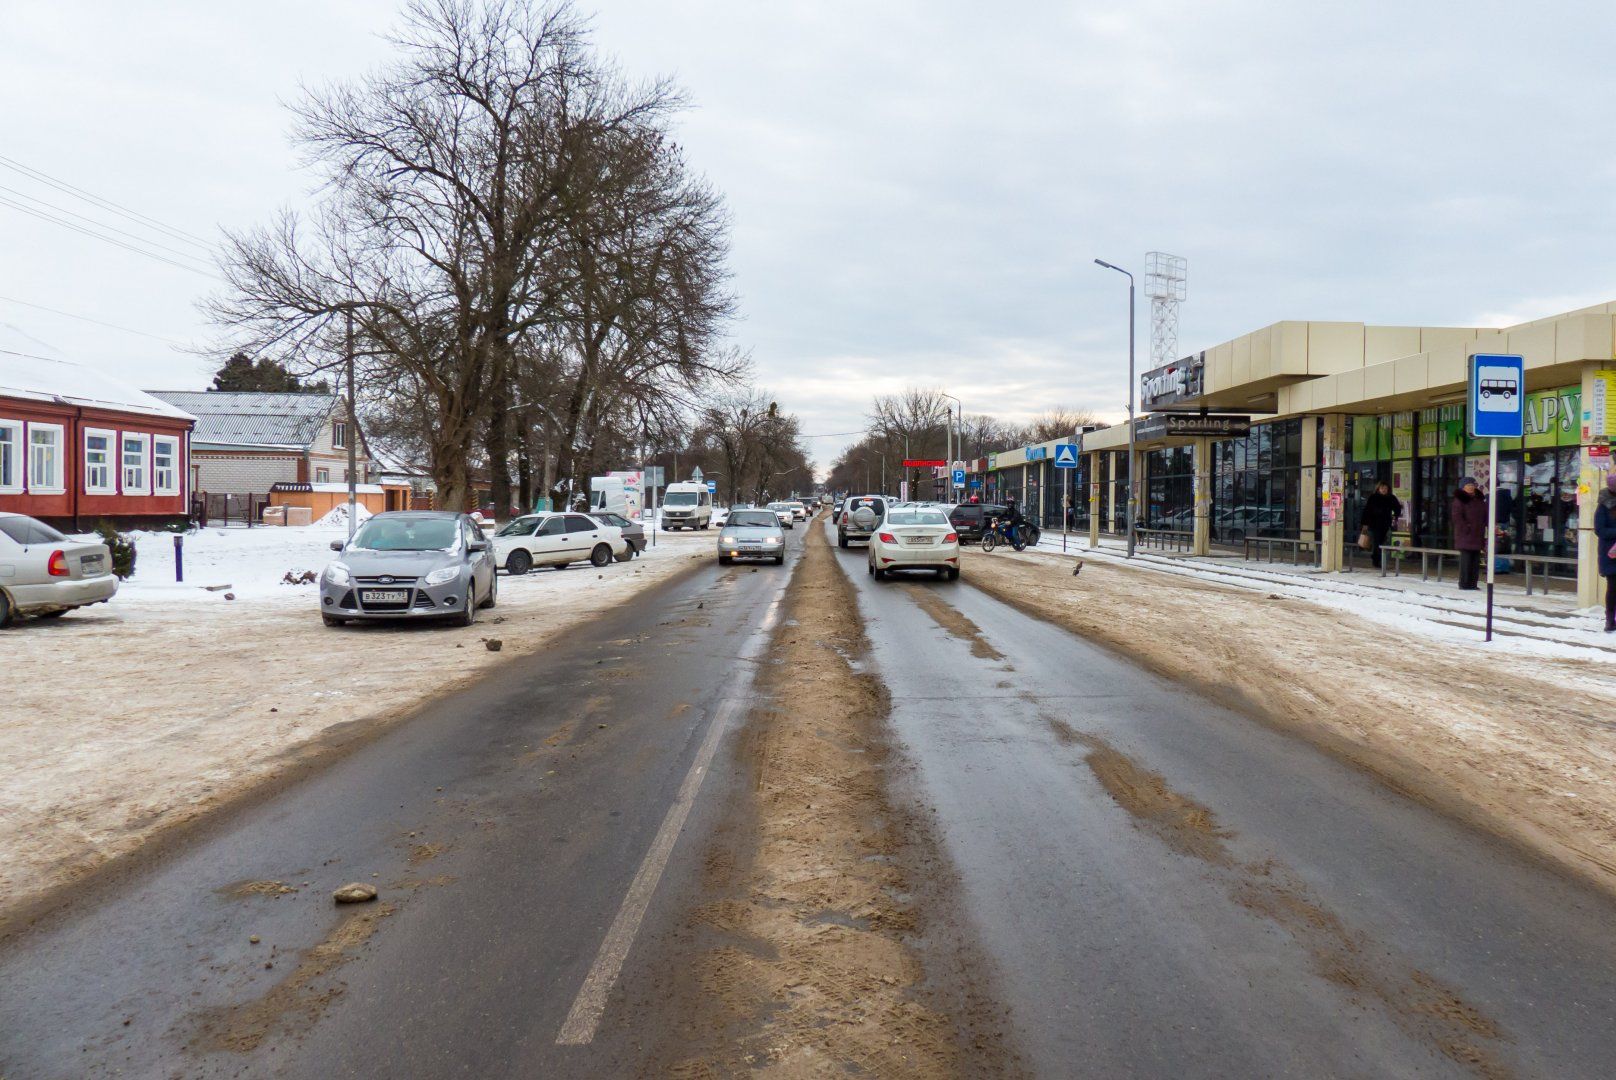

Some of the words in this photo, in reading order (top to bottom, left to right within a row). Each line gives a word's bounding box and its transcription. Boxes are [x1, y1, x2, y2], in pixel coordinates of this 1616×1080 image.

[1141, 366, 1187, 404] Sporting
[1169, 416, 1230, 431] Sporting
[955, 471, 963, 482] P
